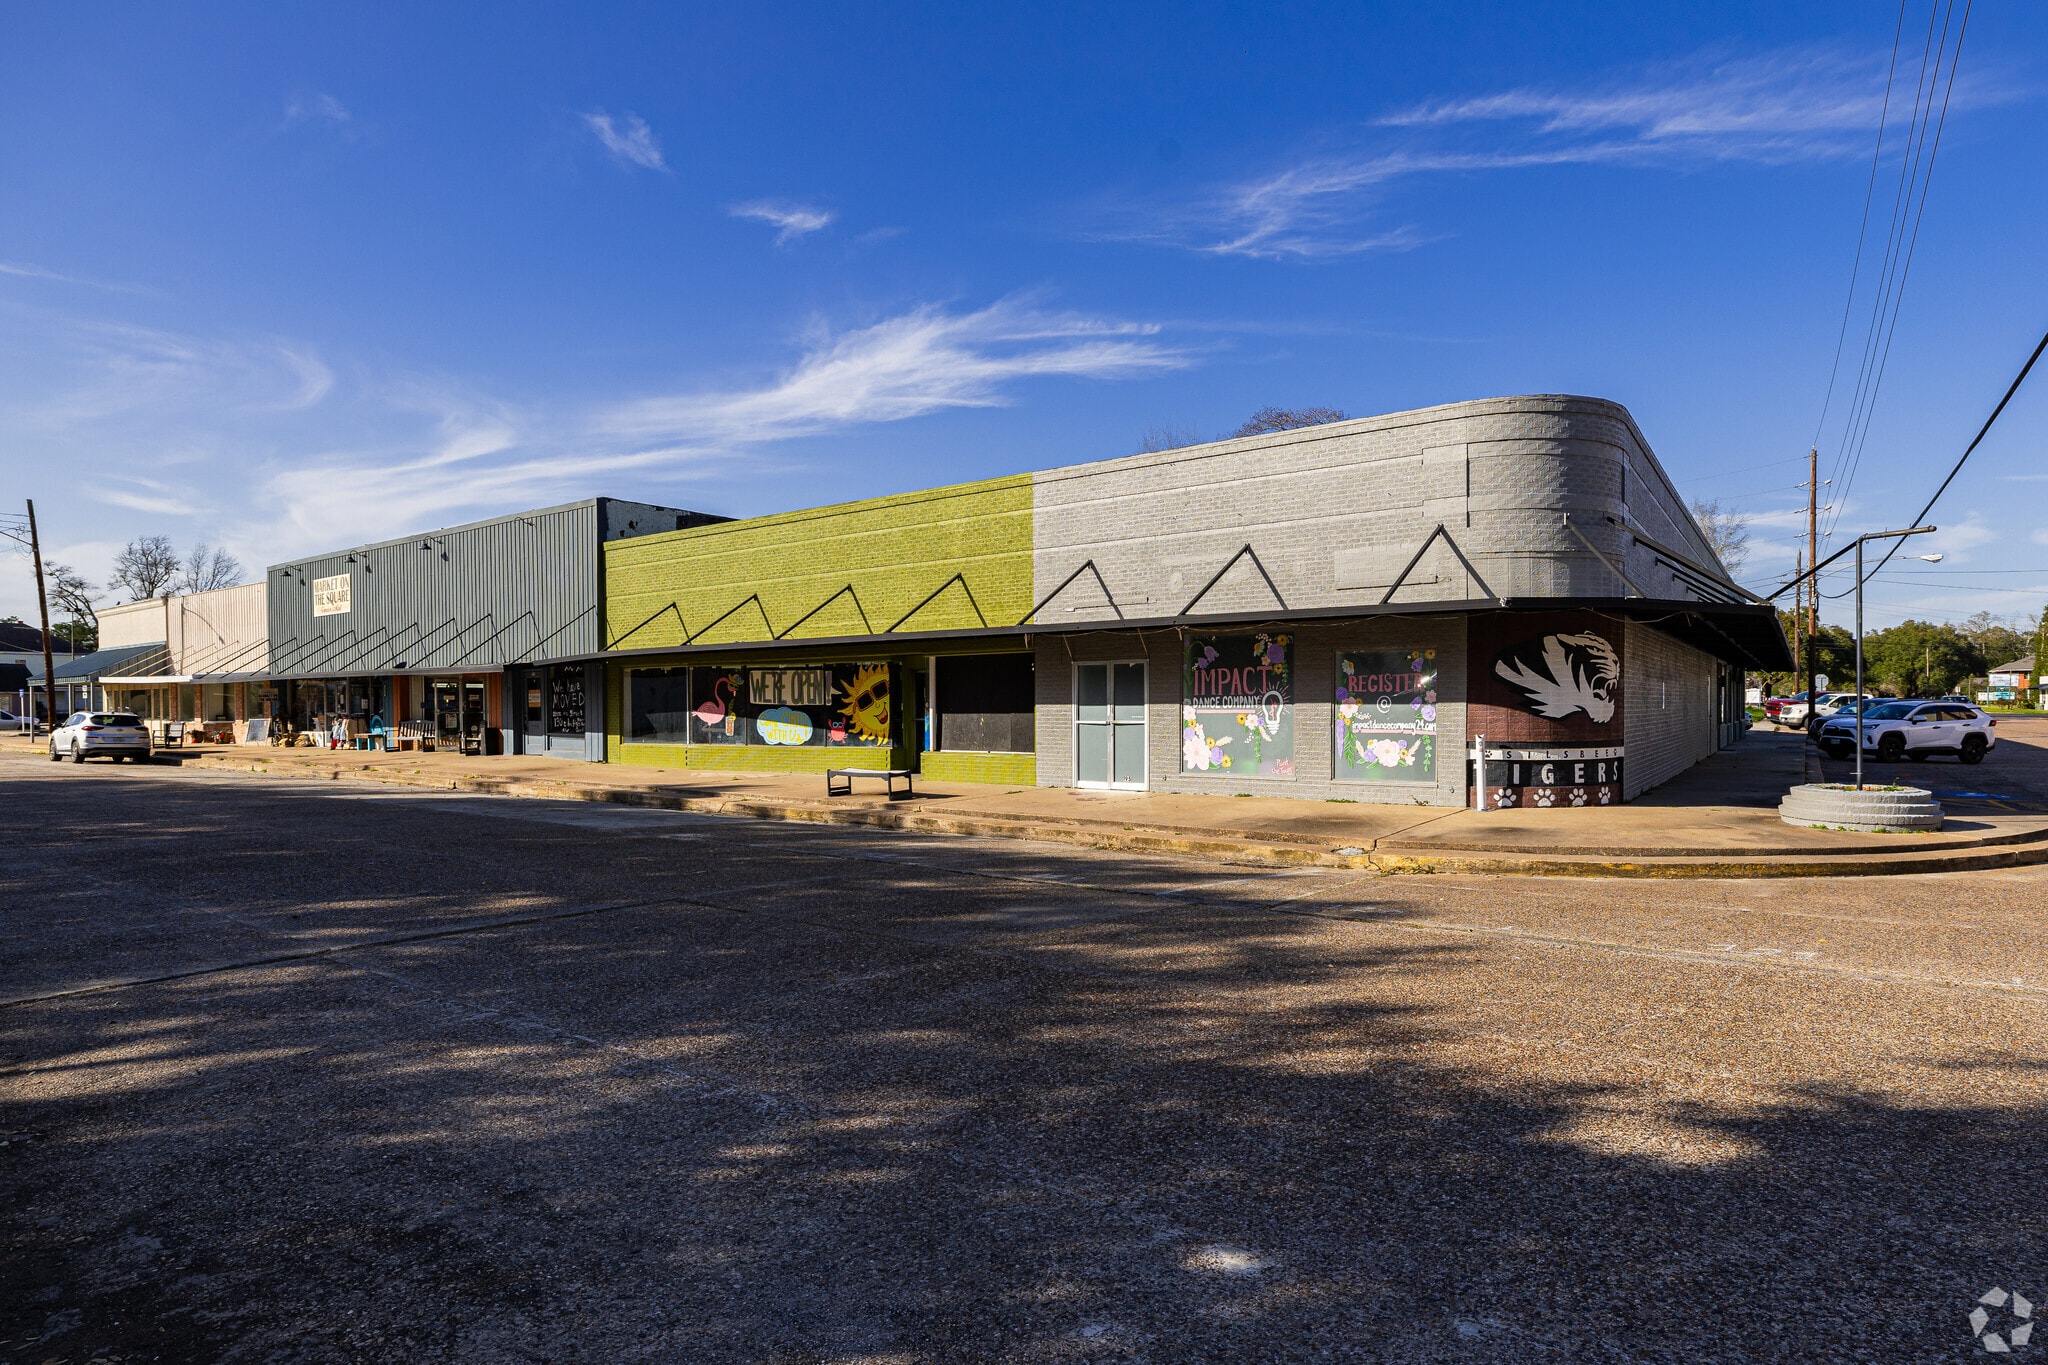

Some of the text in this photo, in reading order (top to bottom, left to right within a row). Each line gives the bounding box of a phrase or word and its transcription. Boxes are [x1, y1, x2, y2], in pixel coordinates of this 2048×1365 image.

[314, 576, 350, 593] MARKET ON
[315, 590, 349, 606] THE SQUARE
[552, 680, 564, 693] We
[1193, 665, 1273, 696] IMPACT
[1348, 673, 1425, 693] REGISTER
[552, 692, 586, 709] MOVED
[1192, 695, 1261, 708] DANCE COMPANY
[1506, 749, 1609, 759] SILSBEE
